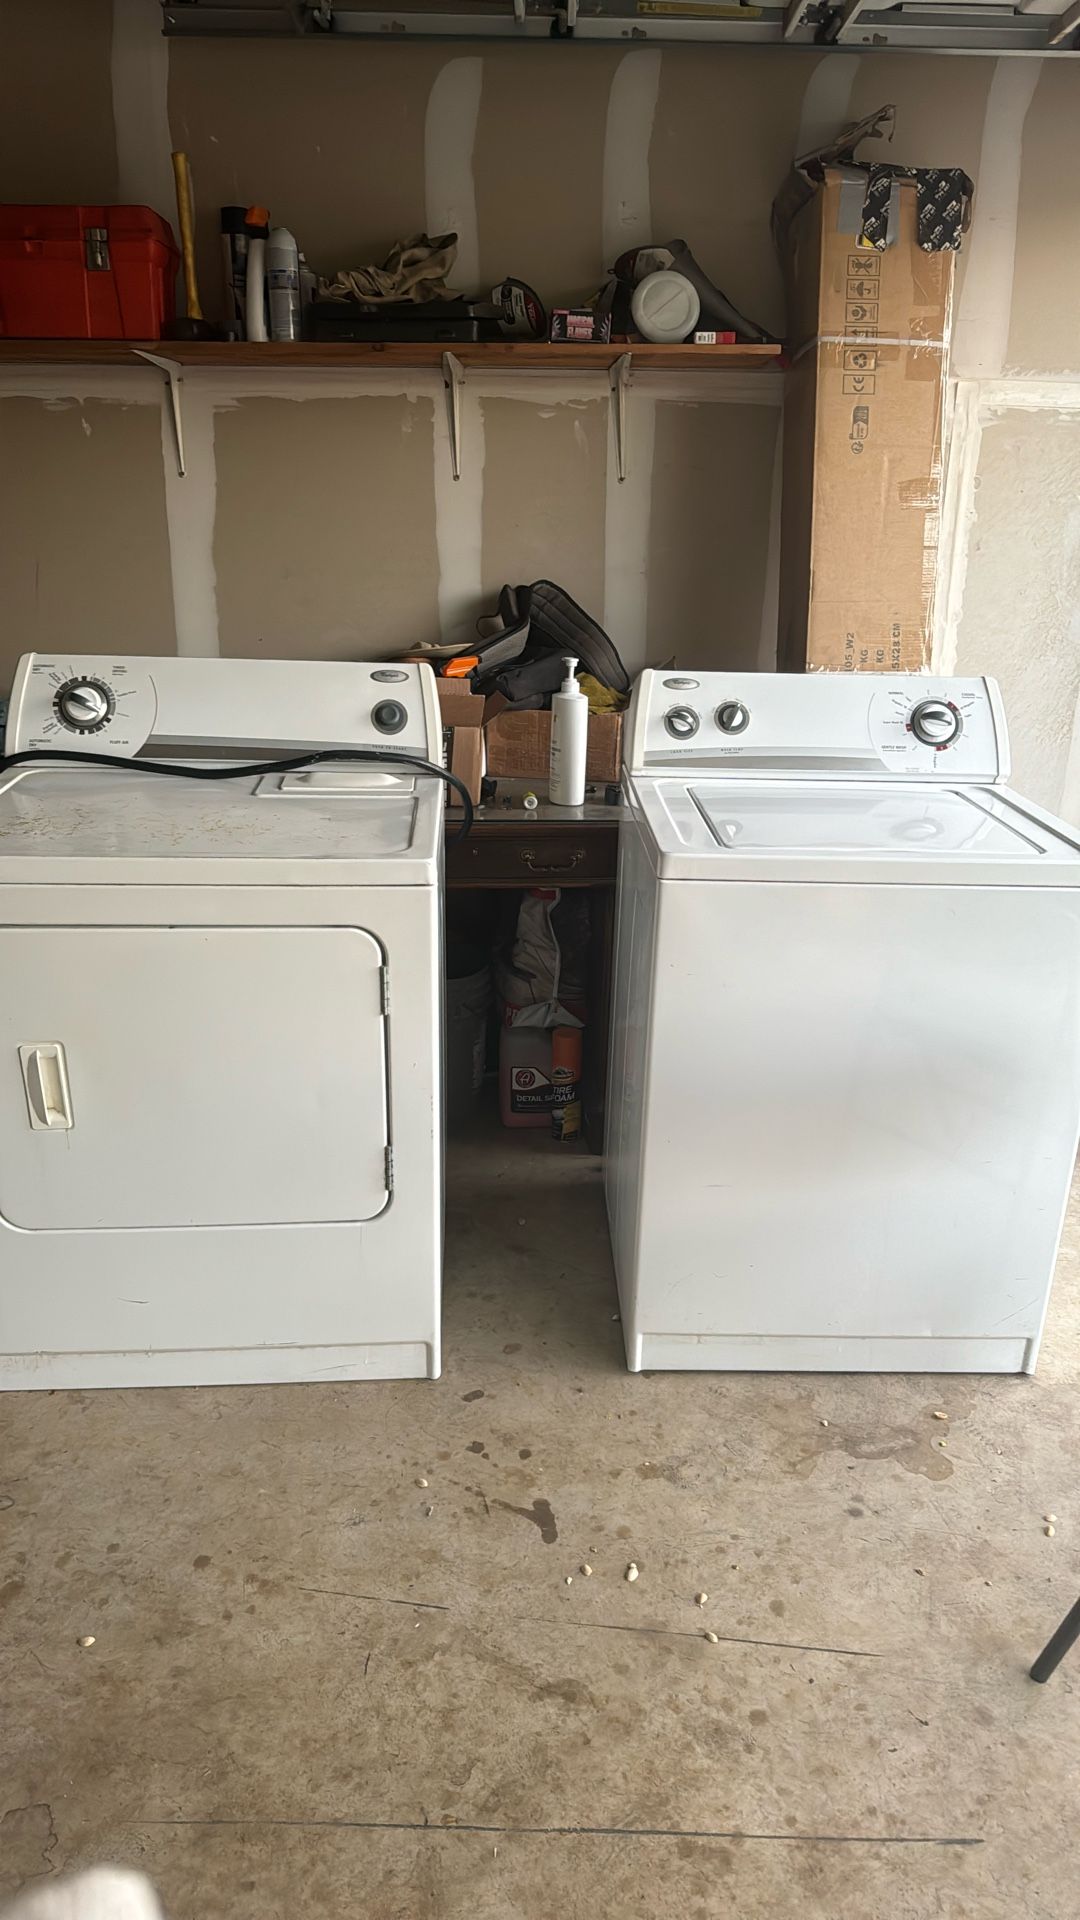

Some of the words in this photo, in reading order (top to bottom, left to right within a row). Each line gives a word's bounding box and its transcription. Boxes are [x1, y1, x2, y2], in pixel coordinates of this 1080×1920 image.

[892, 623, 902, 638] CM
[859, 649, 869, 663] KG
[875, 649, 885, 663] KG
[553, 1086, 572, 1095] TIRE
